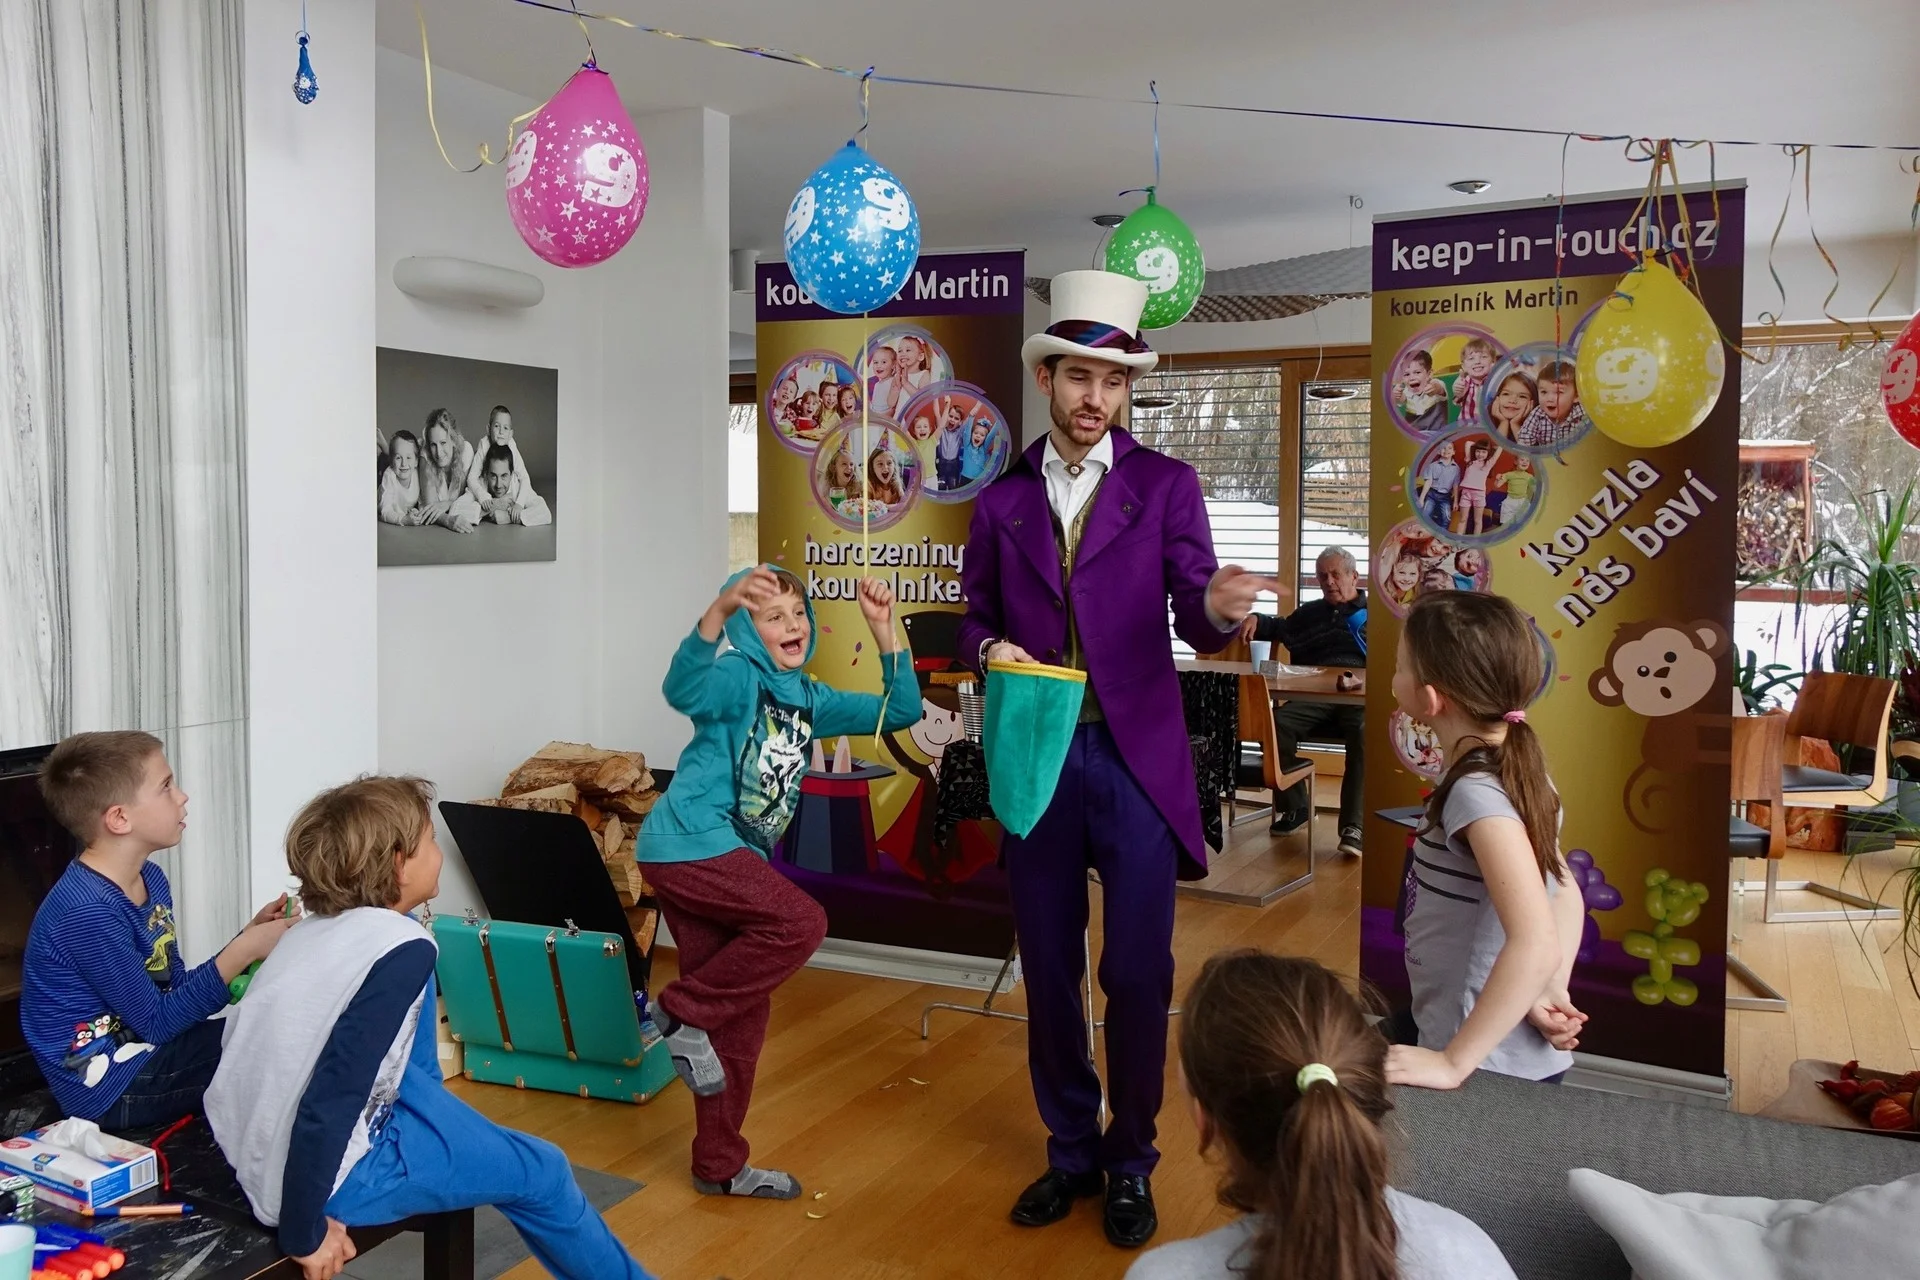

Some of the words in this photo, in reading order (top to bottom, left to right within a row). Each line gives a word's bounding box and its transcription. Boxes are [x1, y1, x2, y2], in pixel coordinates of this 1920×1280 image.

[915, 268, 1009, 301] Martin
[1390, 291, 1495, 317] kouzelník
[1505, 286, 1578, 309] Martin
[1524, 459, 1661, 576] kouzla
[805, 535, 966, 574] narozeniny
[1553, 566, 1633, 628] nás
[1619, 468, 1718, 559] baví
[807, 570, 968, 602] koulníke
